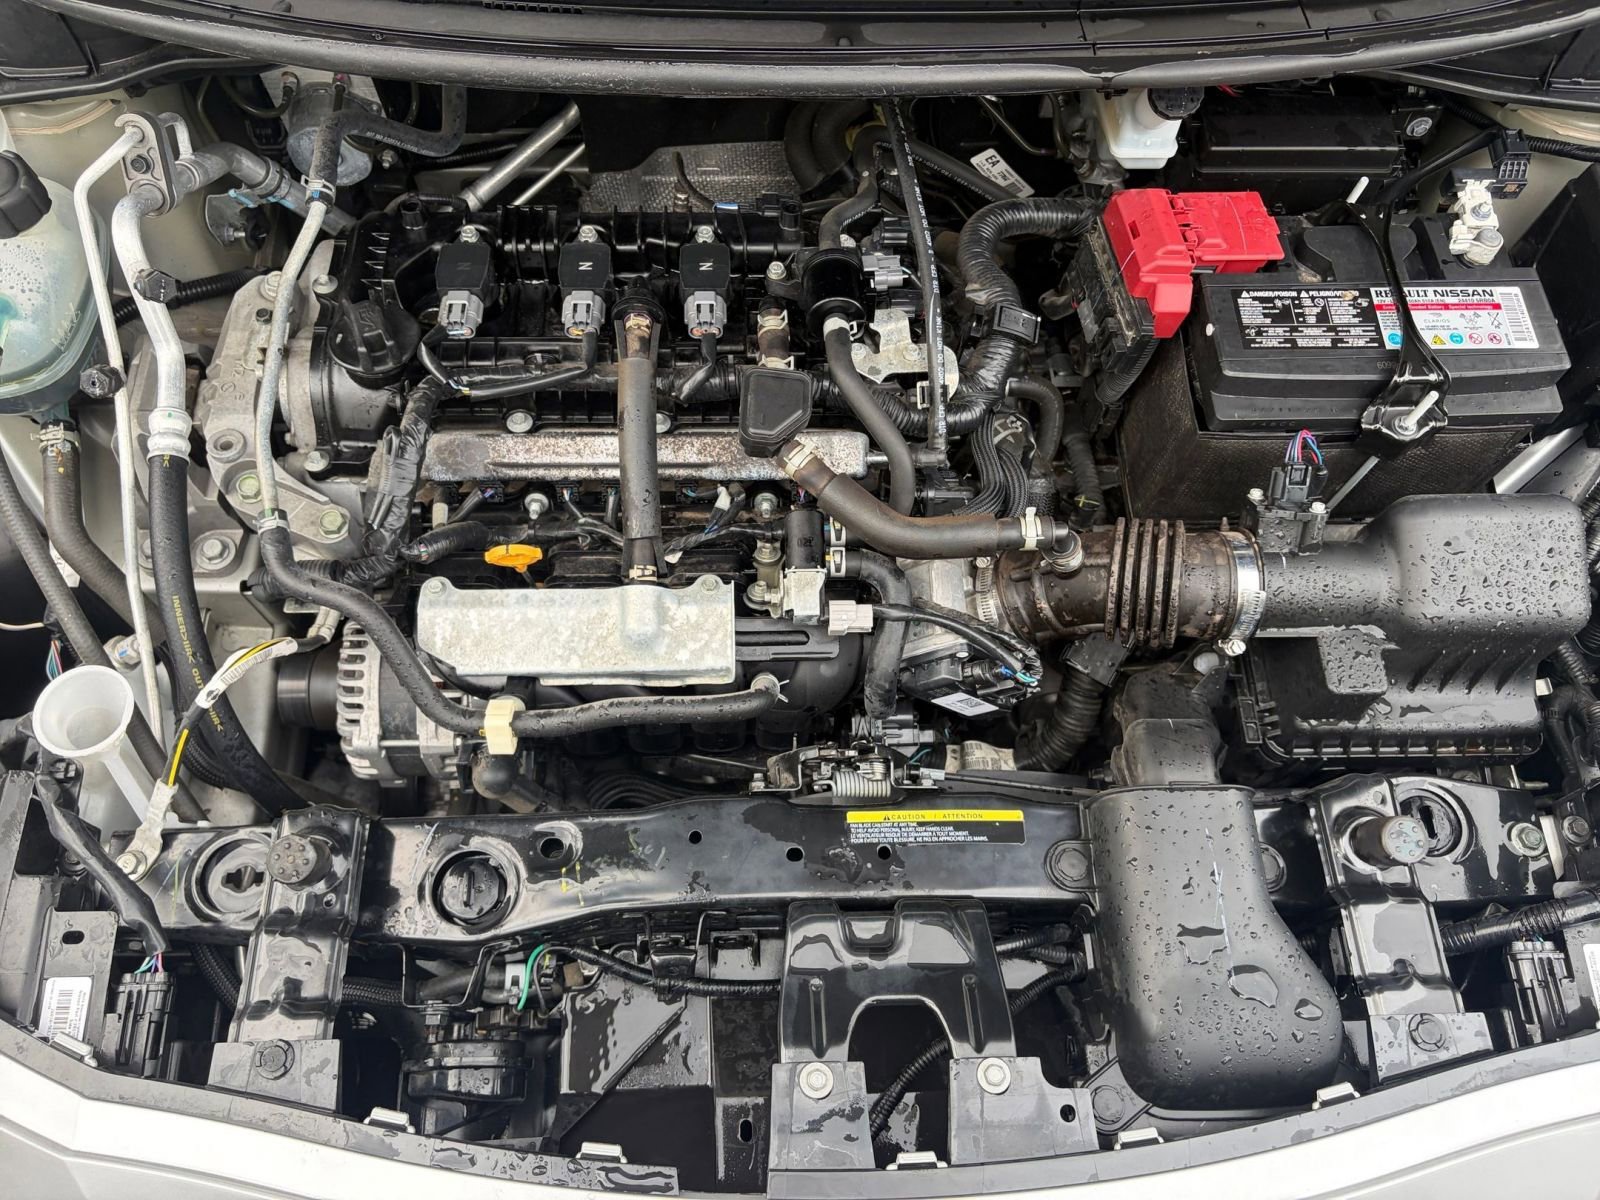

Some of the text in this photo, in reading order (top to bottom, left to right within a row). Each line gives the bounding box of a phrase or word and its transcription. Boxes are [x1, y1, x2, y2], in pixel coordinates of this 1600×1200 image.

[985, 154, 1001, 168] EA
[1433, 288, 1495, 298] NISSAN
[935, 316, 943, 334] KINK
